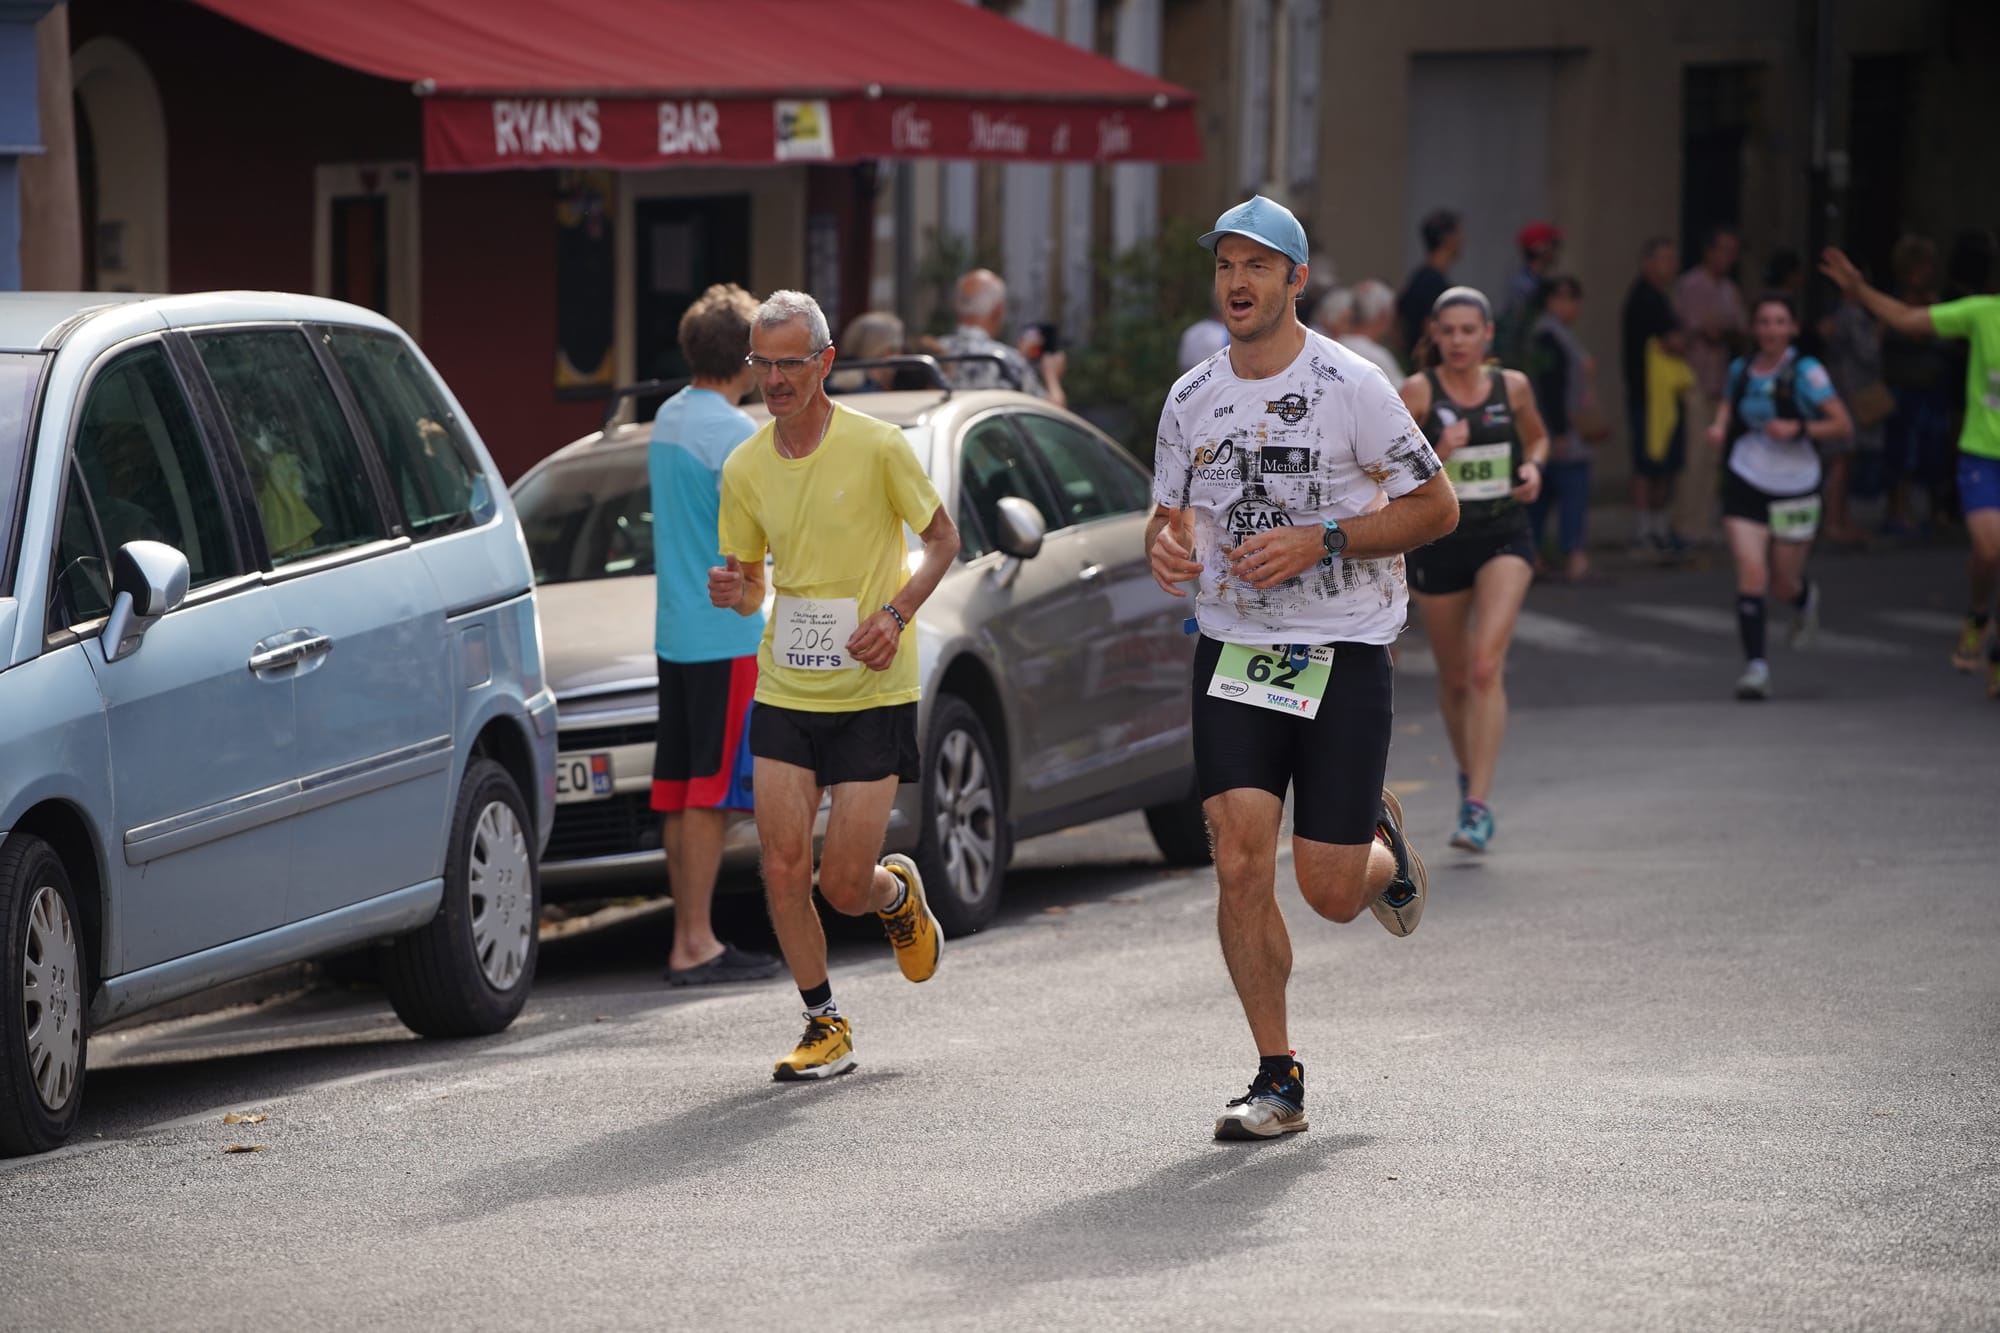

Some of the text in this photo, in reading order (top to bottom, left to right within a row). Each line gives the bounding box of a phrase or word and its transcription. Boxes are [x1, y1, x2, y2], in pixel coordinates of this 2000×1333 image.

[492, 99, 602, 155] RYAN'S
[657, 101, 721, 155] BAR
[1264, 459, 1308, 473] Mende
[1460, 460, 1494, 481] 68
[1234, 511, 1285, 529] STAR
[789, 627, 834, 651] 206
[786, 653, 842, 667] TUFF'S
[1246, 655, 1296, 690] 62
[1266, 693, 1298, 706] TUFF'S
